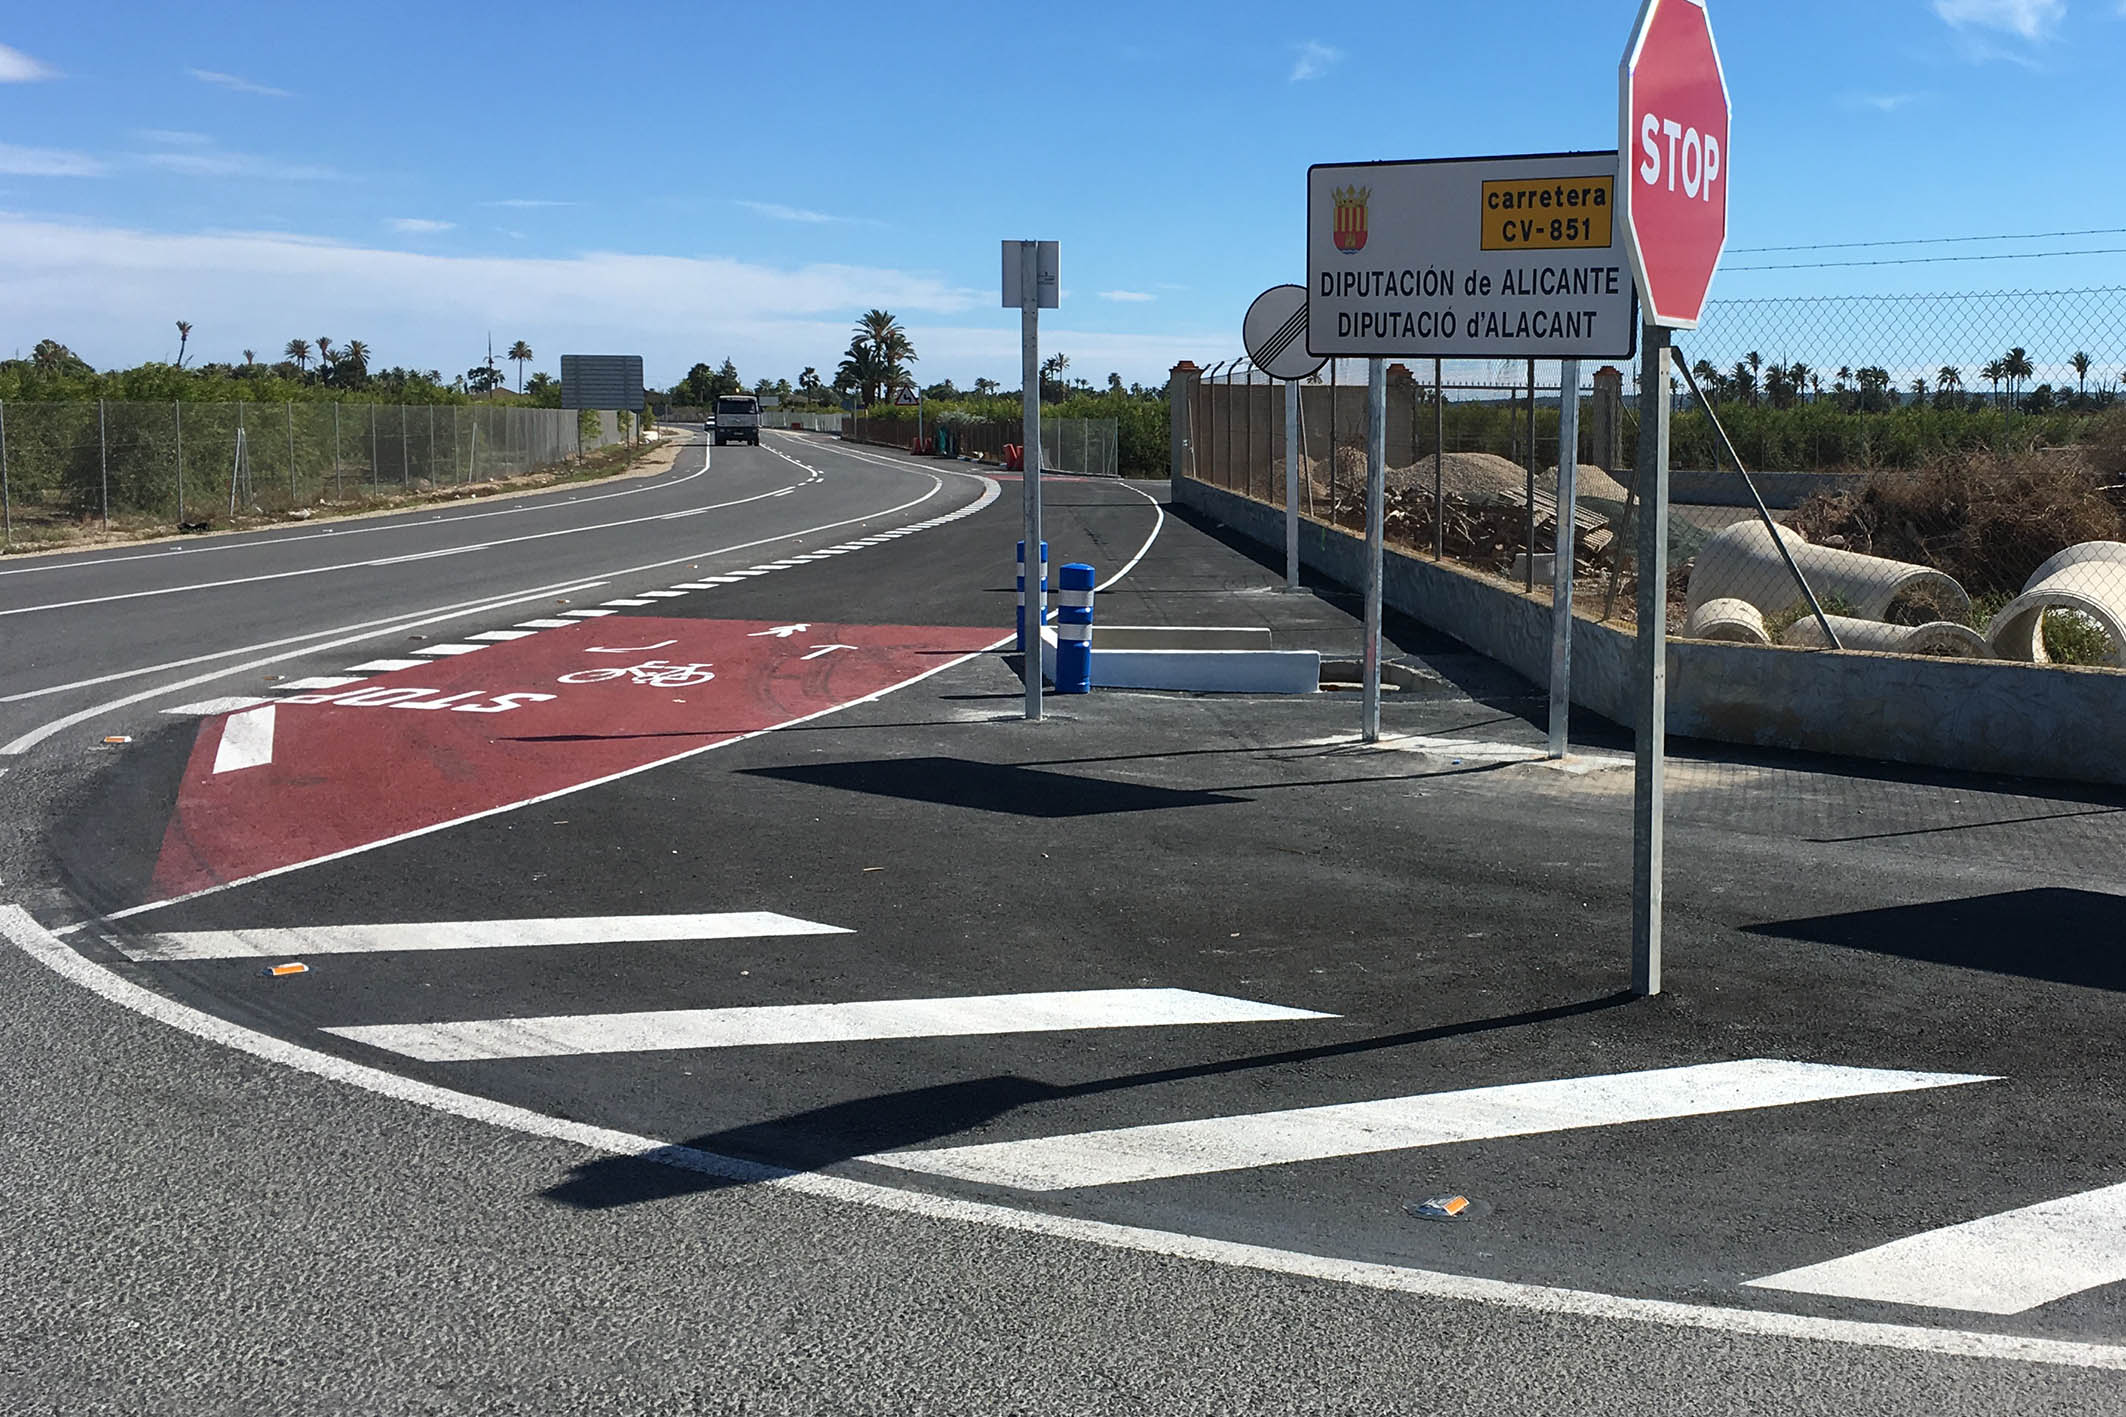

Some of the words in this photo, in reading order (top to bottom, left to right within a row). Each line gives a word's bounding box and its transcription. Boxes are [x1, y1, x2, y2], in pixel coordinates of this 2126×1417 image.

[1640, 113, 1720, 202] STOP
[1487, 185, 1606, 210] carretera
[1502, 217, 1591, 242] CV-851
[1320, 264, 1454, 298] DIPUTACIÓN
[1464, 269, 1492, 296] de
[1501, 266, 1620, 296] ALICANTE
[1338, 306, 1457, 339] DIPUTACIÓ
[1466, 310, 1598, 339] d'ALACANT
[273, 686, 558, 713] STOP
